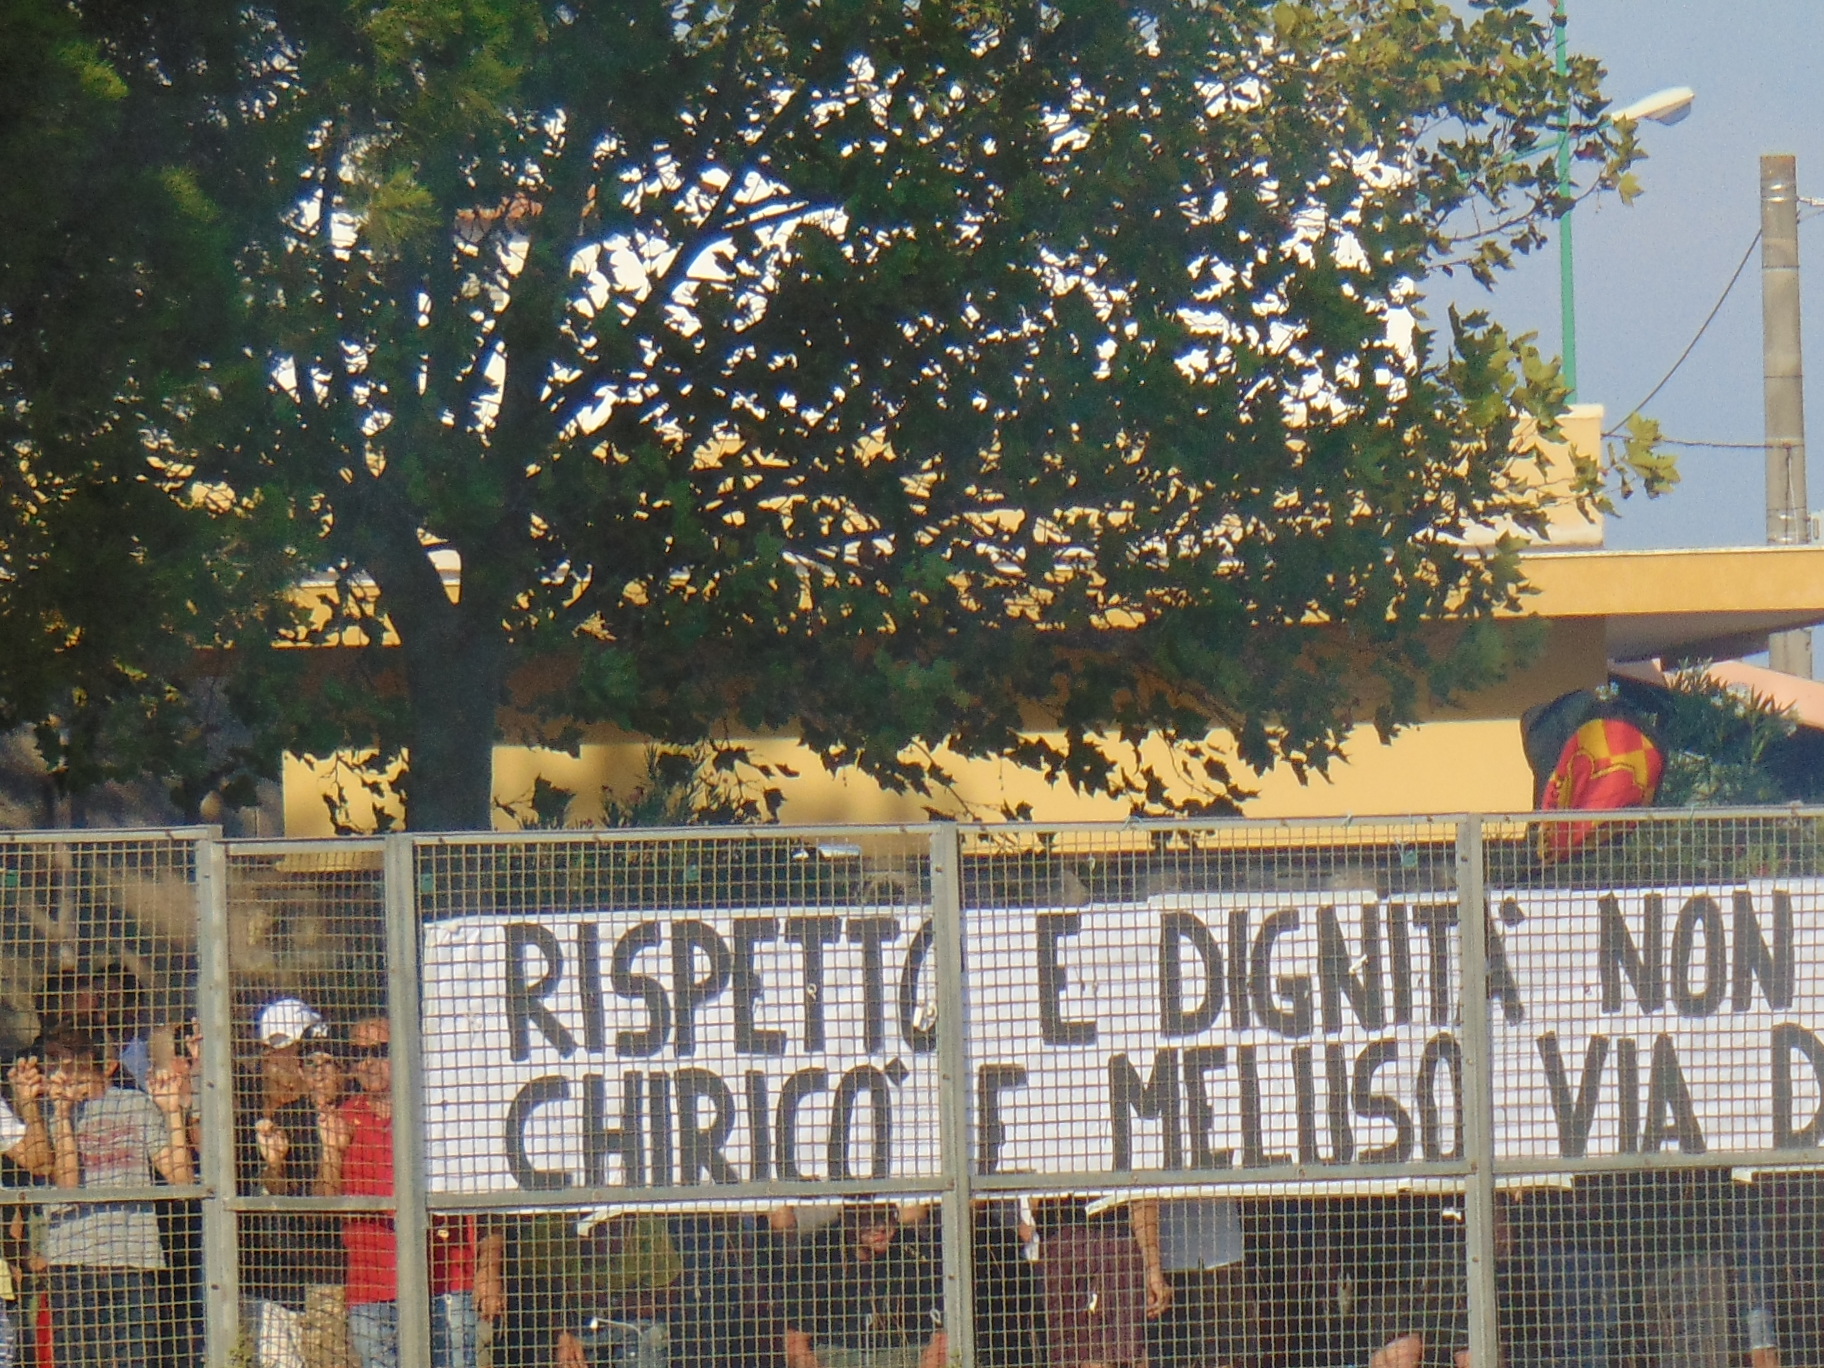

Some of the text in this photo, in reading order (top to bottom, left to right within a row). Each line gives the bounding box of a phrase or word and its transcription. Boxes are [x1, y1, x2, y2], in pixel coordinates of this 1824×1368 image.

[503, 916, 944, 1061] RISPETTO
[1036, 912, 1096, 1045] E
[1599, 888, 1795, 1018] NON
[505, 1056, 909, 1191] CHIRICO'
[978, 1063, 1036, 1174] E
[1107, 1032, 1463, 1172] MELUSO
[1536, 1031, 1707, 1157] VIA
